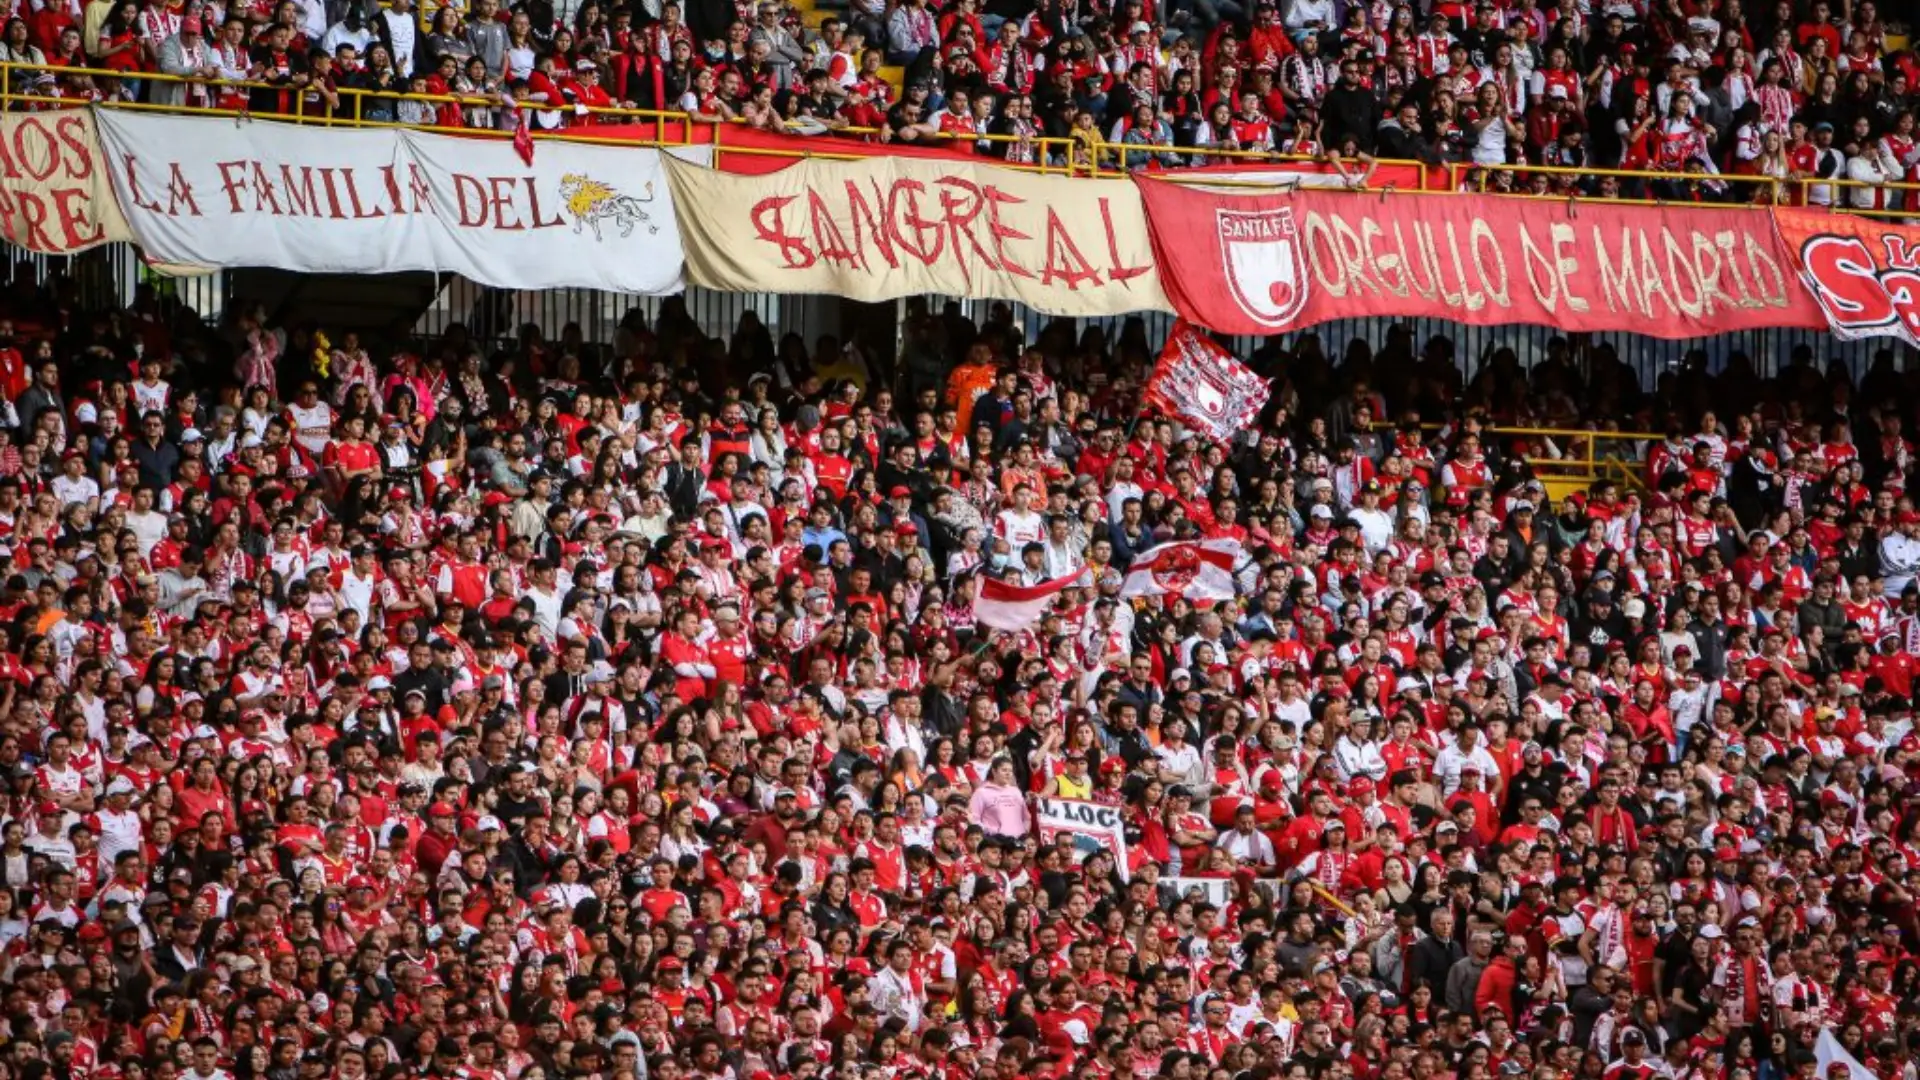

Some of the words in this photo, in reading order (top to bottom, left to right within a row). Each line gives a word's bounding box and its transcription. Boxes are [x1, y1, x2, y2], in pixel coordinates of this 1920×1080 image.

[124, 153, 203, 216] LA
[216, 160, 437, 219] FAMILIA
[452, 173, 566, 229] DEL
[1306, 210, 1511, 311] ORGULLO
[1519, 222, 1589, 314] DE
[1593, 224, 1789, 318] MADRID
